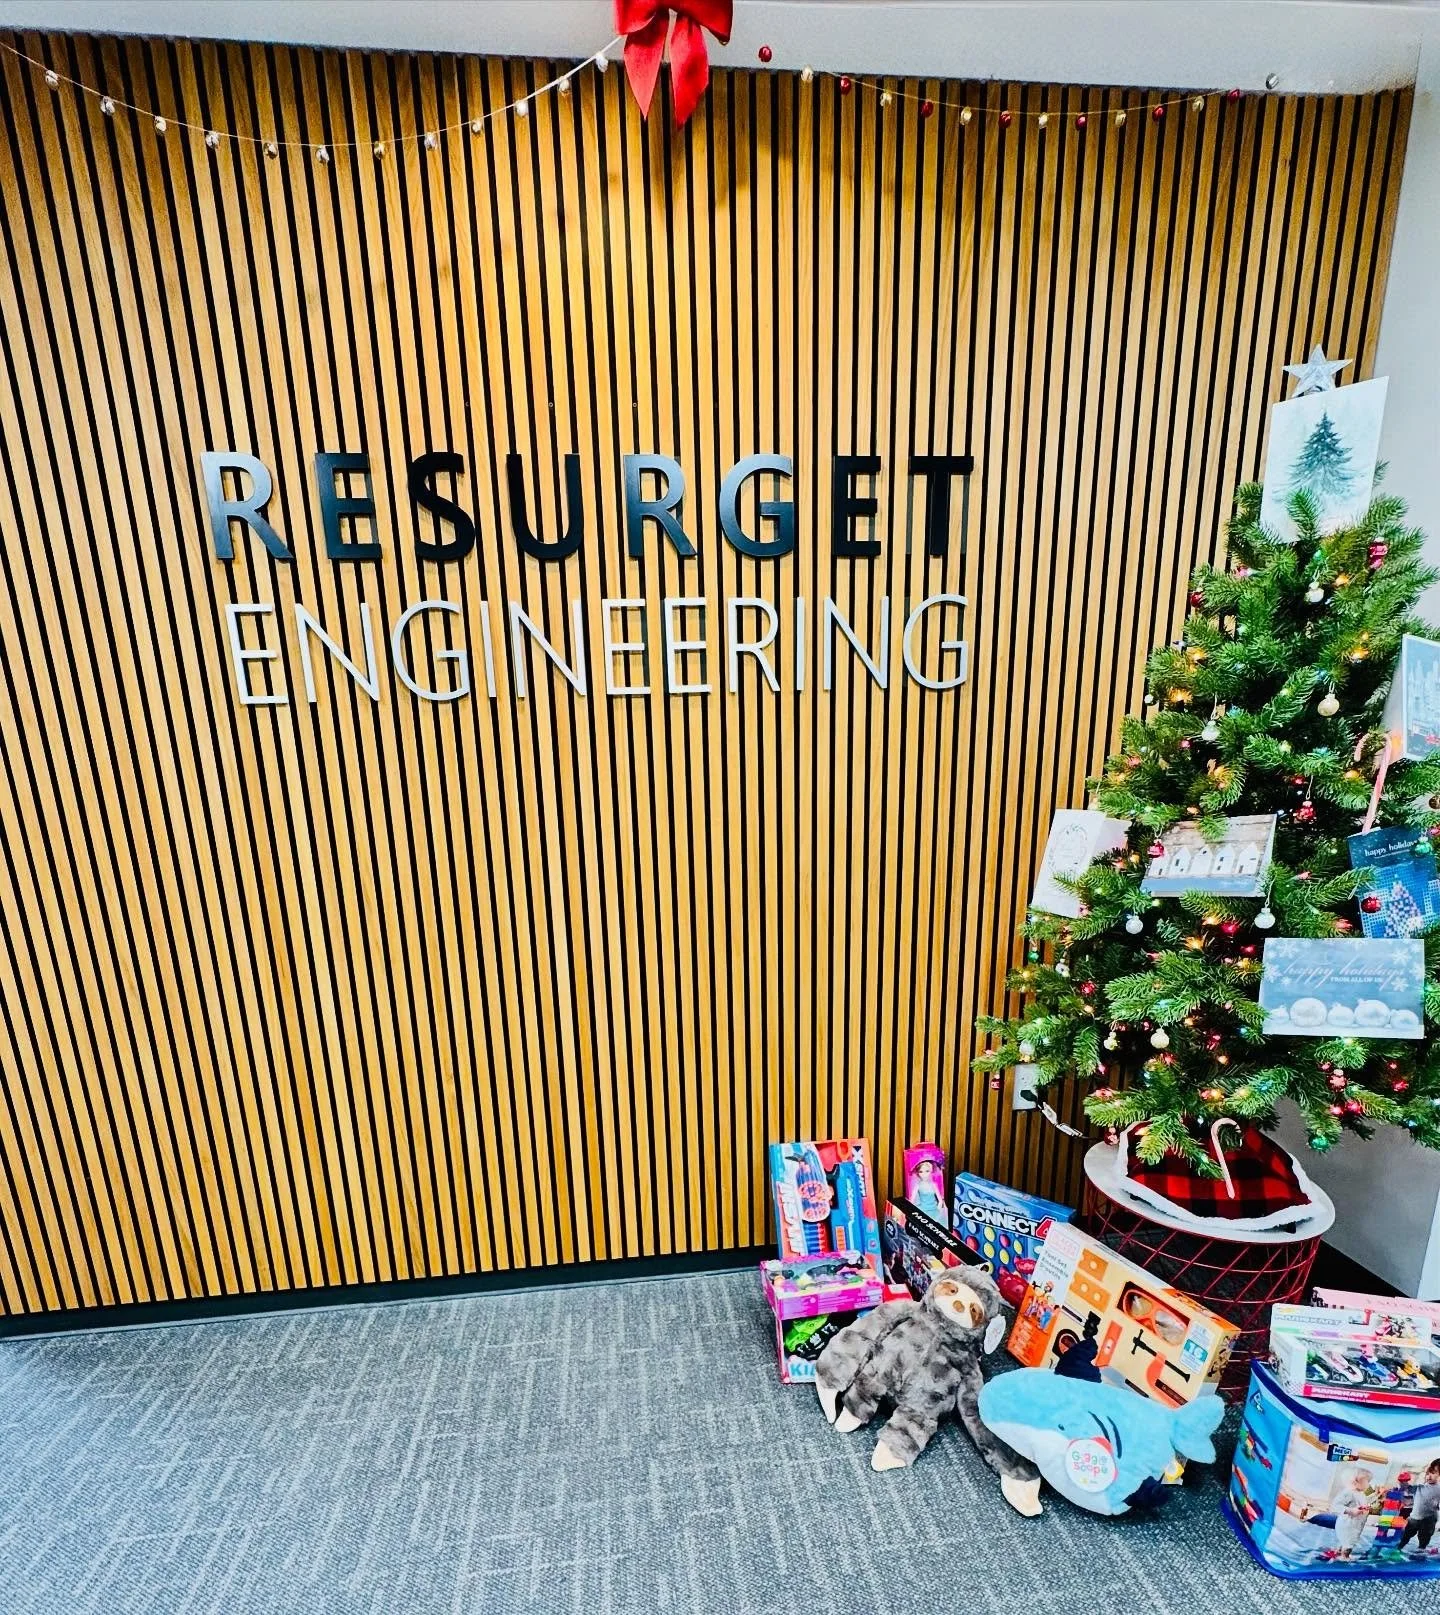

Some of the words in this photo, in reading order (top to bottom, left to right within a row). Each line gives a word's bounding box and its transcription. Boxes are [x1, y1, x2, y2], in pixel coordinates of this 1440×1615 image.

[200, 450, 975, 562] RESURGET
[225, 593, 970, 706] ENGINEERING
[1364, 846, 1387, 858] happy
[1282, 954, 1334, 989] happy
[1339, 953, 1405, 991] holidays
[960, 1203, 1038, 1236] CONNECT
[1035, 1217, 1053, 1240] 4
